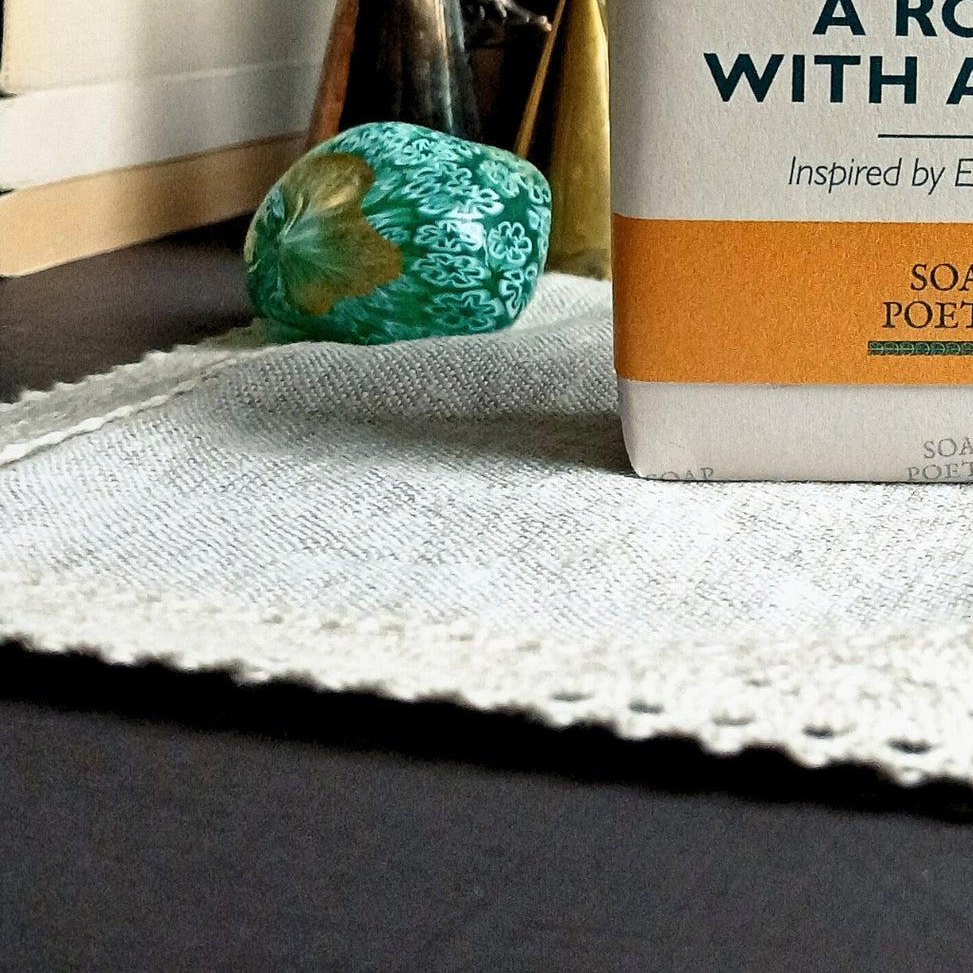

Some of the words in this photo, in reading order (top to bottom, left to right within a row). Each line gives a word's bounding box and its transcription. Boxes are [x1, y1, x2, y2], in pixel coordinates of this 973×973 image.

[703, 52, 918, 105] WITH
[788, 155, 903, 193] Inspired
[911, 157, 946, 195] by
